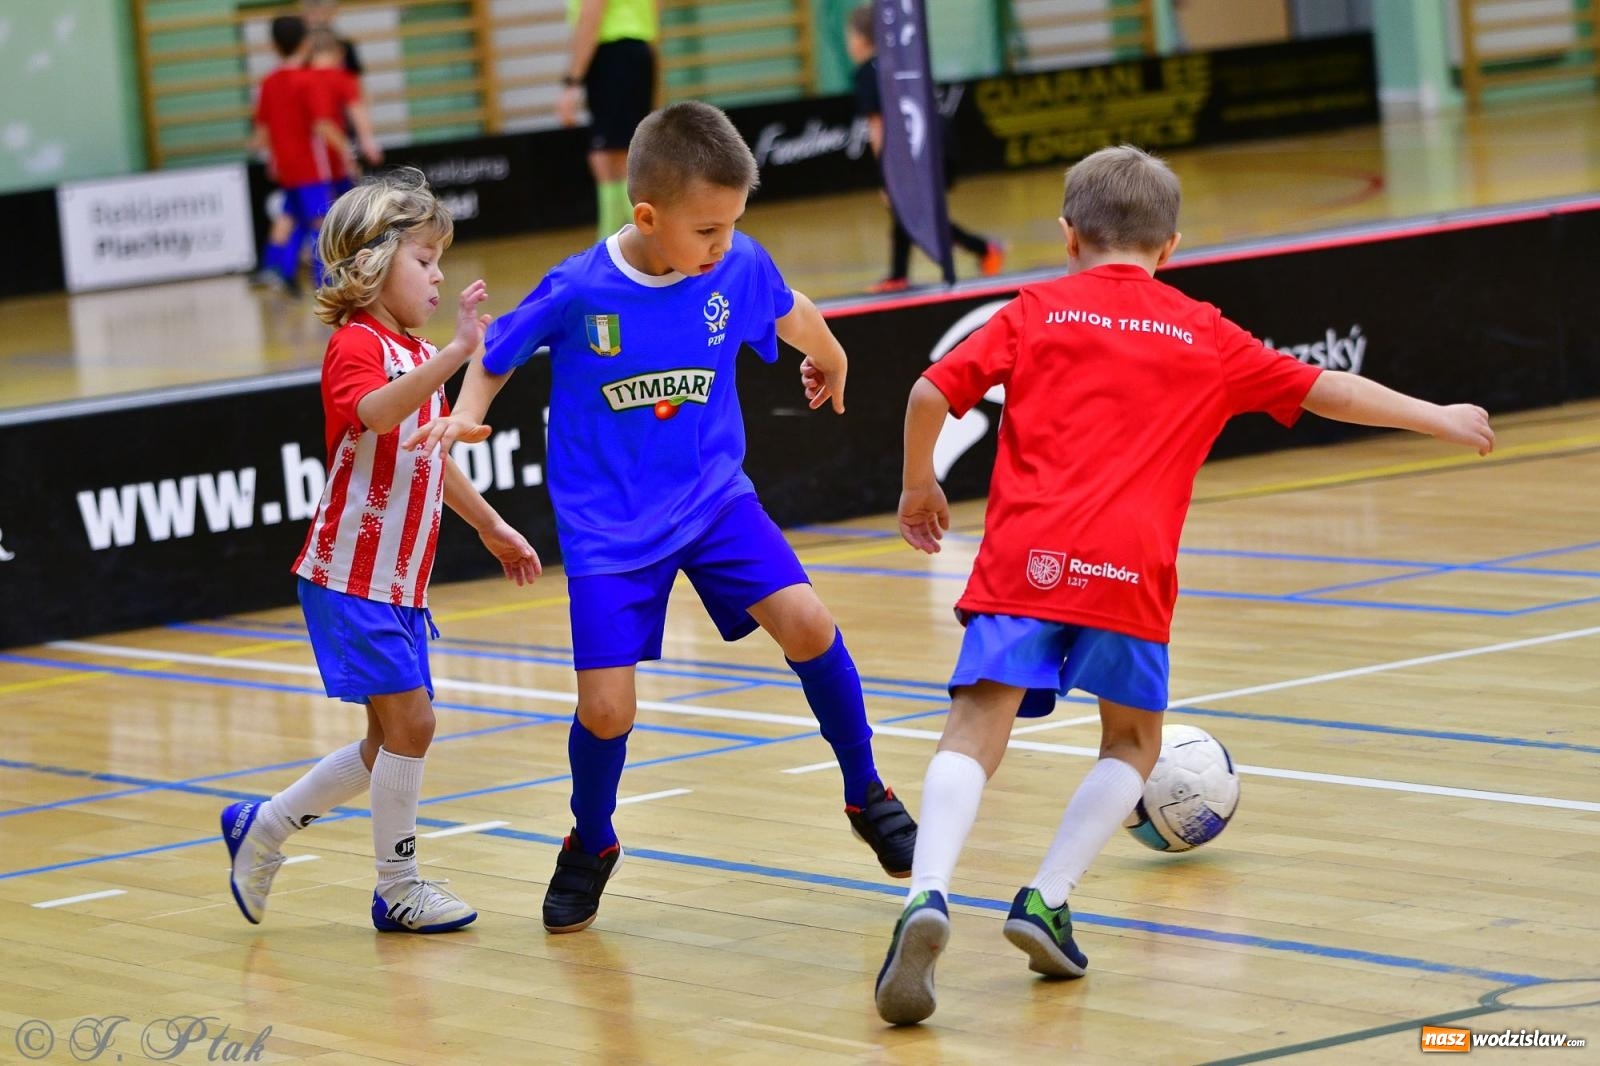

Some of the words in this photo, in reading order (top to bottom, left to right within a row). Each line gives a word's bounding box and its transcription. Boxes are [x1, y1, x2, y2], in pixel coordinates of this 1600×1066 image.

[1046, 310, 1113, 329] JUNIOR
[1118, 318, 1194, 346] TRENING
[1067, 576, 1089, 590] 1217
[1068, 558, 1140, 585] Racibórz
[230, 802, 255, 841] MESSI
